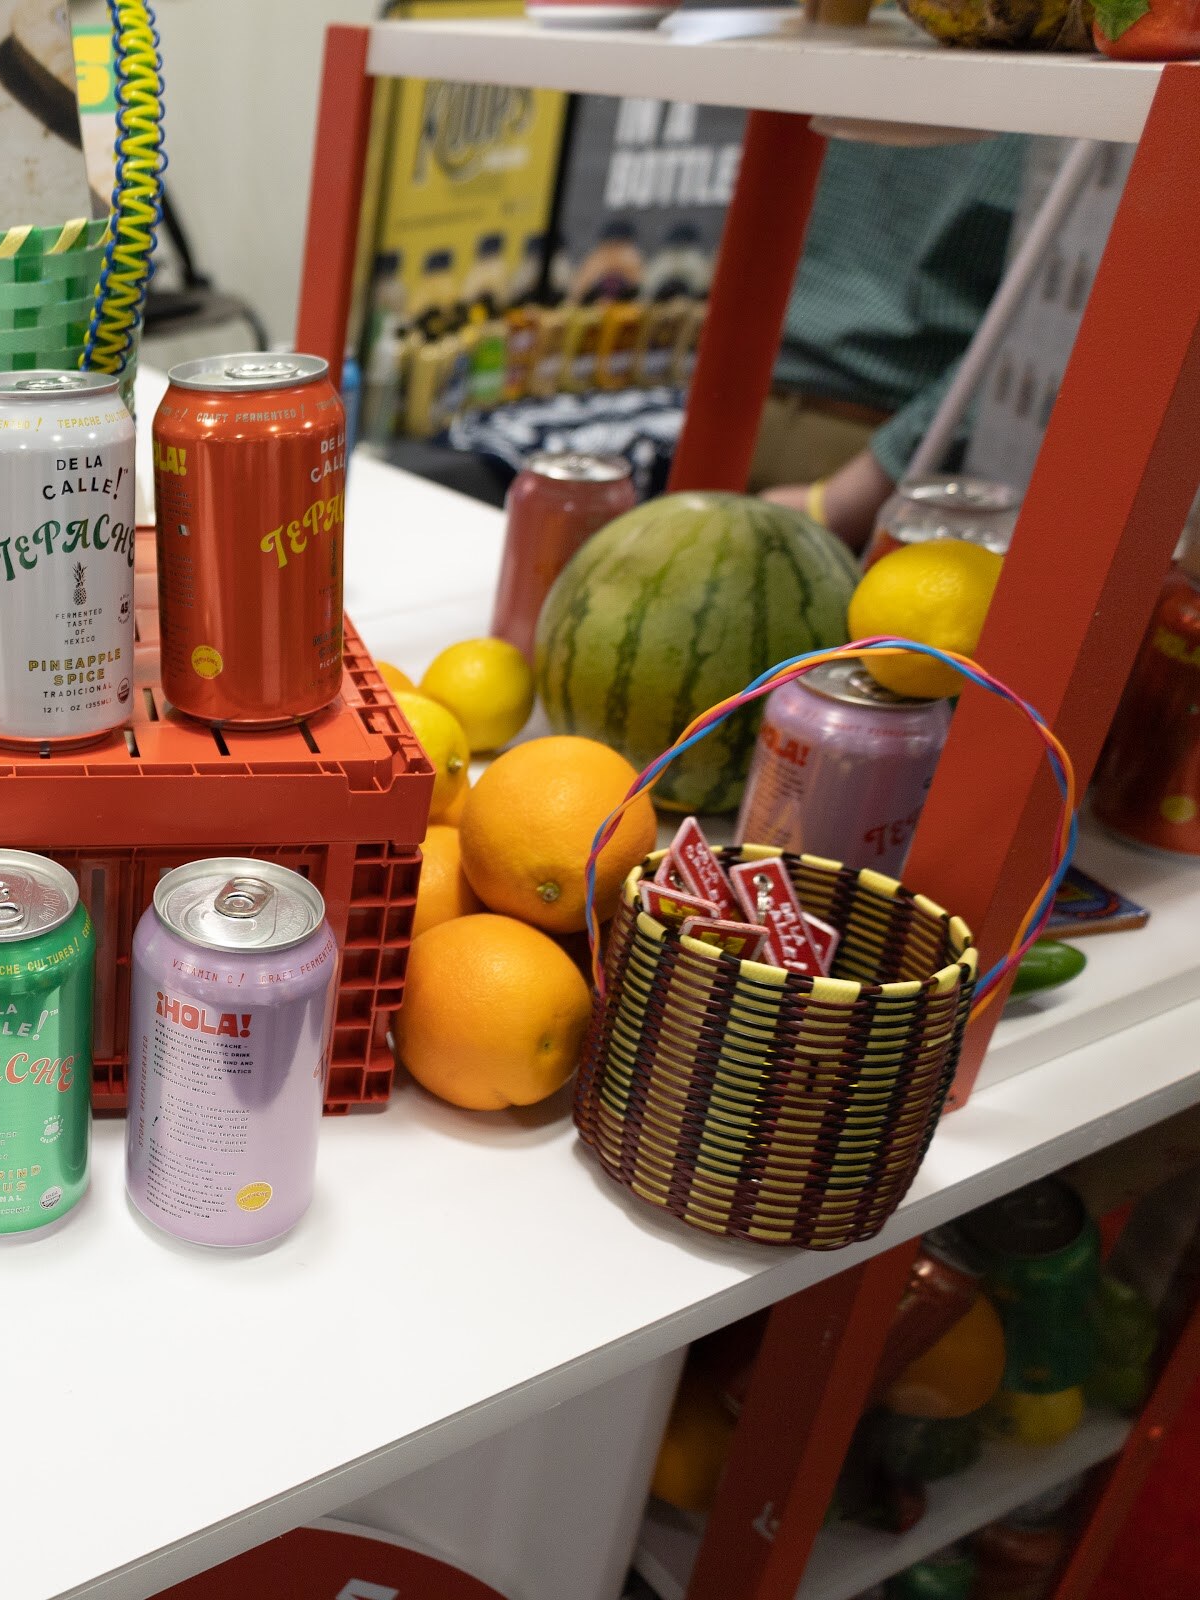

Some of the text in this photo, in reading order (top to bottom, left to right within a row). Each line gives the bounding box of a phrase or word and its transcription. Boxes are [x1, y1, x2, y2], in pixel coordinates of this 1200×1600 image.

[57, 415, 101, 429] TEPACHE
[196, 412, 229, 424] CRAFT
[320, 439, 335, 454] DE
[56, 455, 103, 471] DE LA
[42, 466, 123, 500] CALLE!
[259, 494, 345, 570] TEPA
[55, 607, 103, 620] FERMENTED
[67, 619, 93, 627] TASTE
[64, 635, 96, 646] MEXICO
[28, 648, 122, 671] PINEAPPLE
[53, 668, 106, 686] SPICE
[43, 683, 113, 699] TRADICIONAL
[172, 958, 294, 985] VITAMIN CRAFT
[155, 991, 253, 1039] ¡HOLA!
